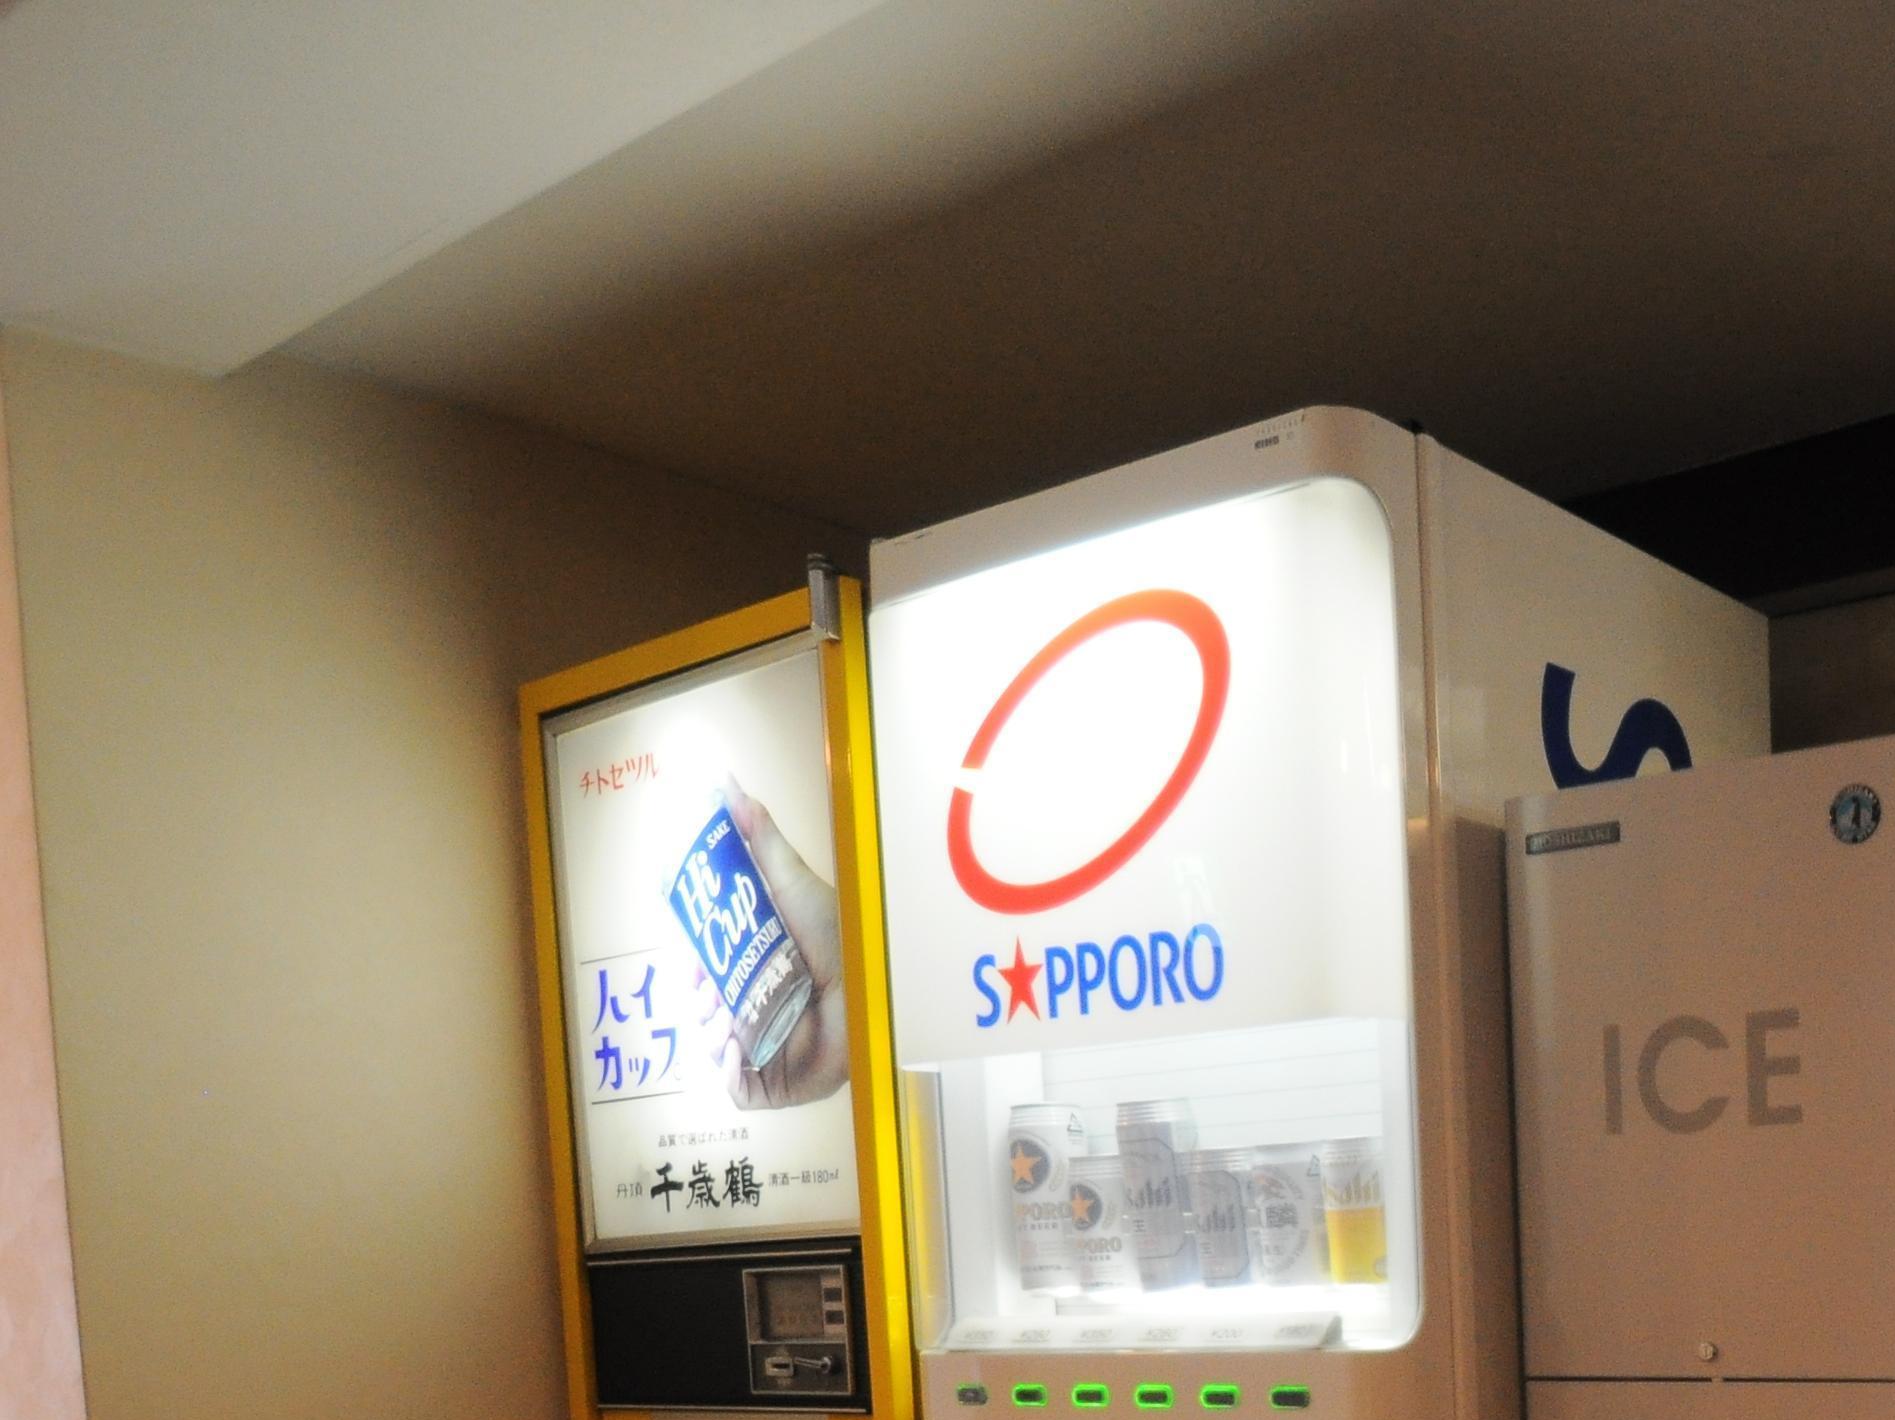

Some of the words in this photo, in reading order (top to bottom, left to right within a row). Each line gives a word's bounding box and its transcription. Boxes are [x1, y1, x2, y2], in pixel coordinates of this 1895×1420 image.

[579, 752, 662, 798] チトセツル
[678, 850, 720, 938] Hi
[703, 872, 758, 975] Cup
[592, 964, 656, 1034] ハイ
[1604, 1007, 1803, 1136] ICE
[651, 1157, 765, 1213] 千歳鶴
